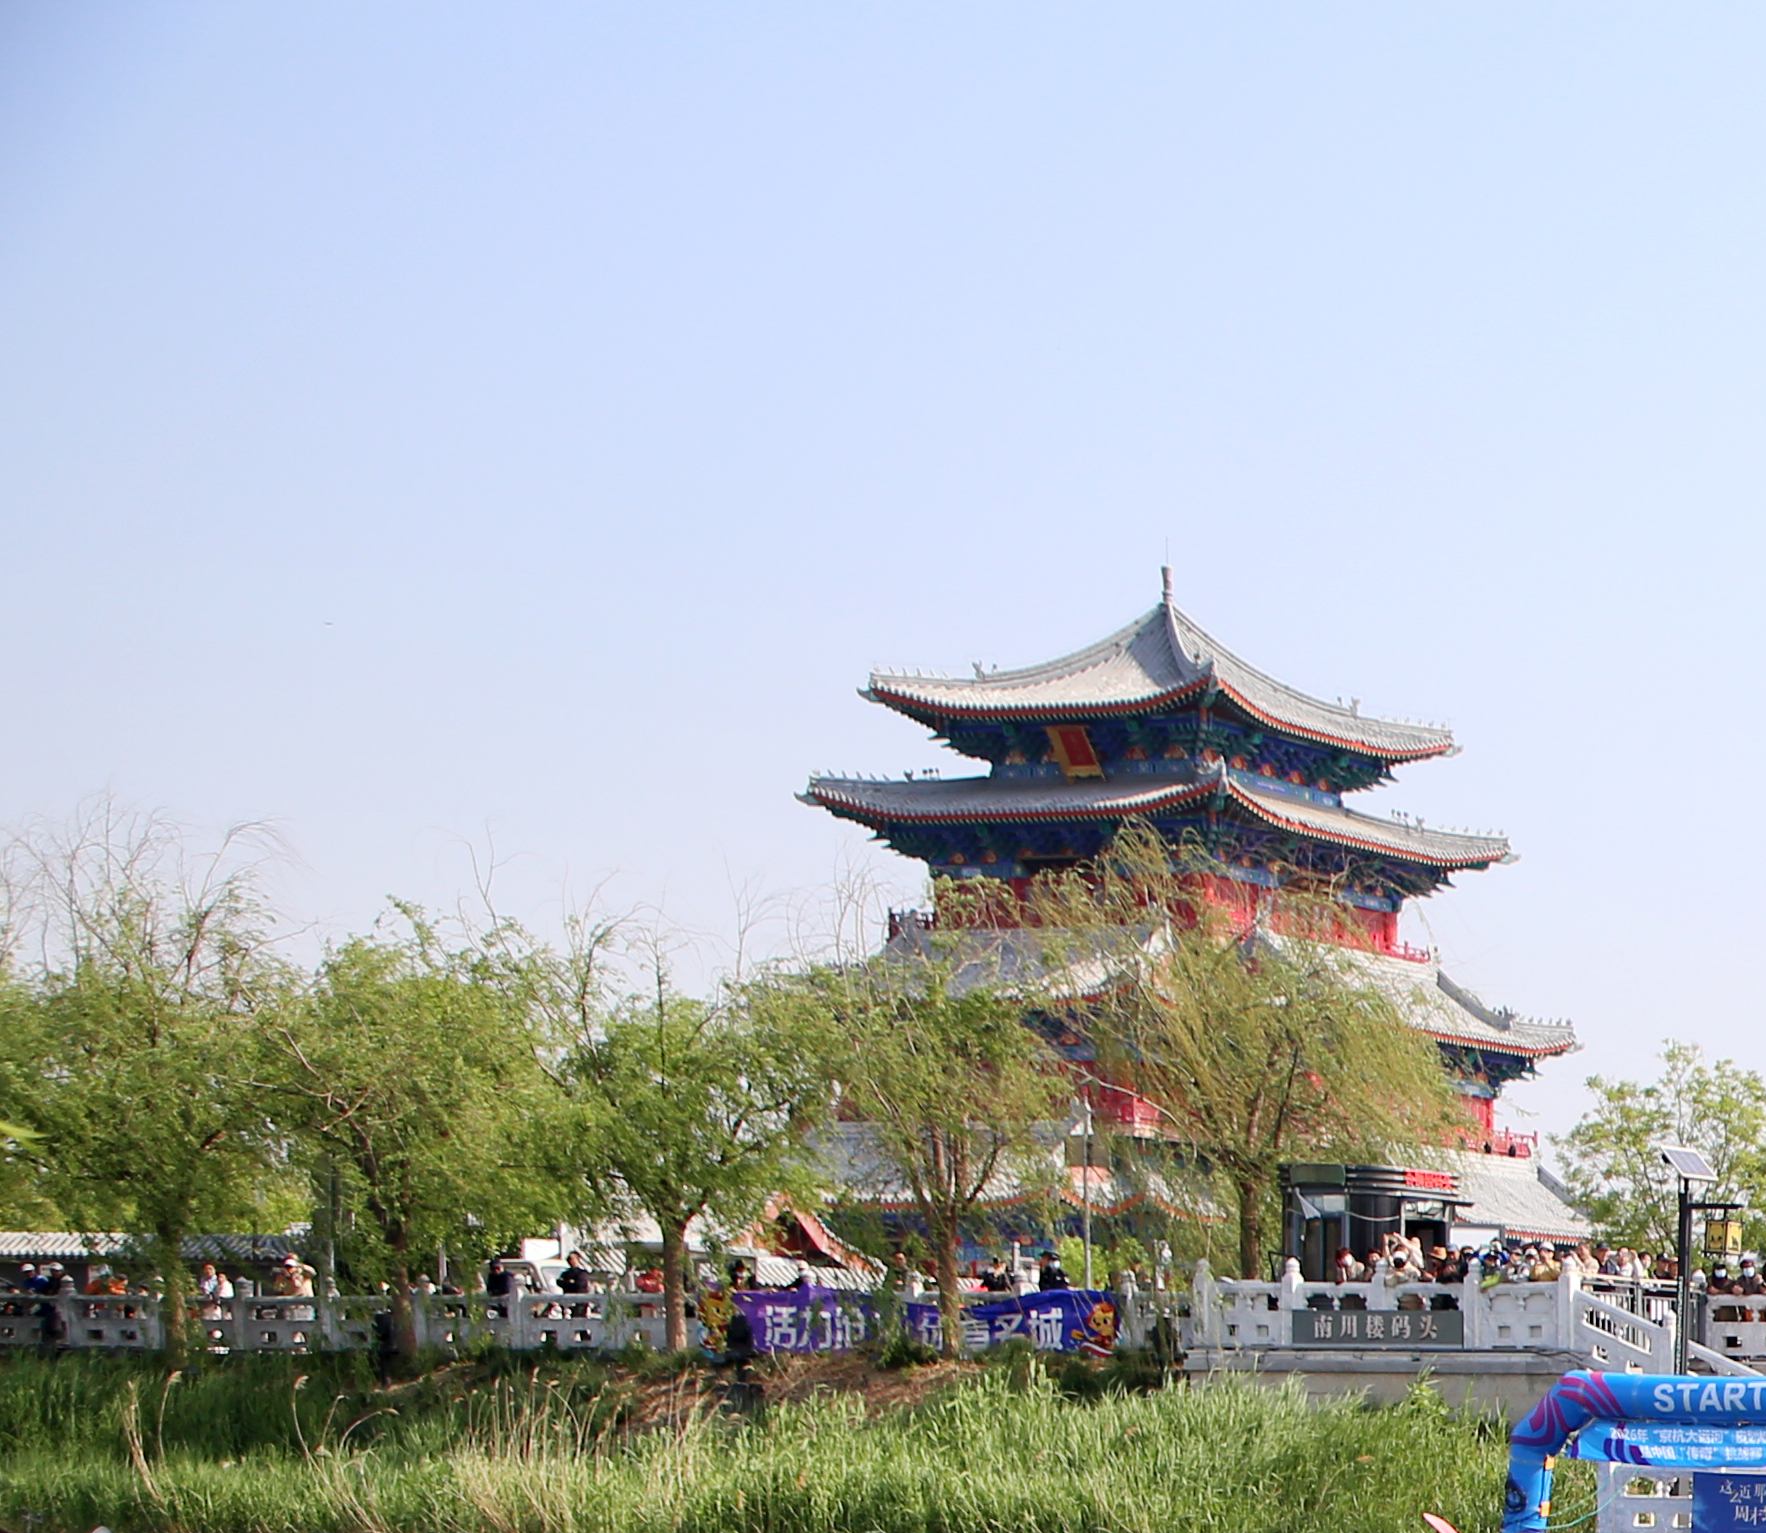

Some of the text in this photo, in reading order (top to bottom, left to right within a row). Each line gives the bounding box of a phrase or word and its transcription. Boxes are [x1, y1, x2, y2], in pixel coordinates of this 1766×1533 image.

[1314, 1314, 1438, 1340] 南川楼码头
